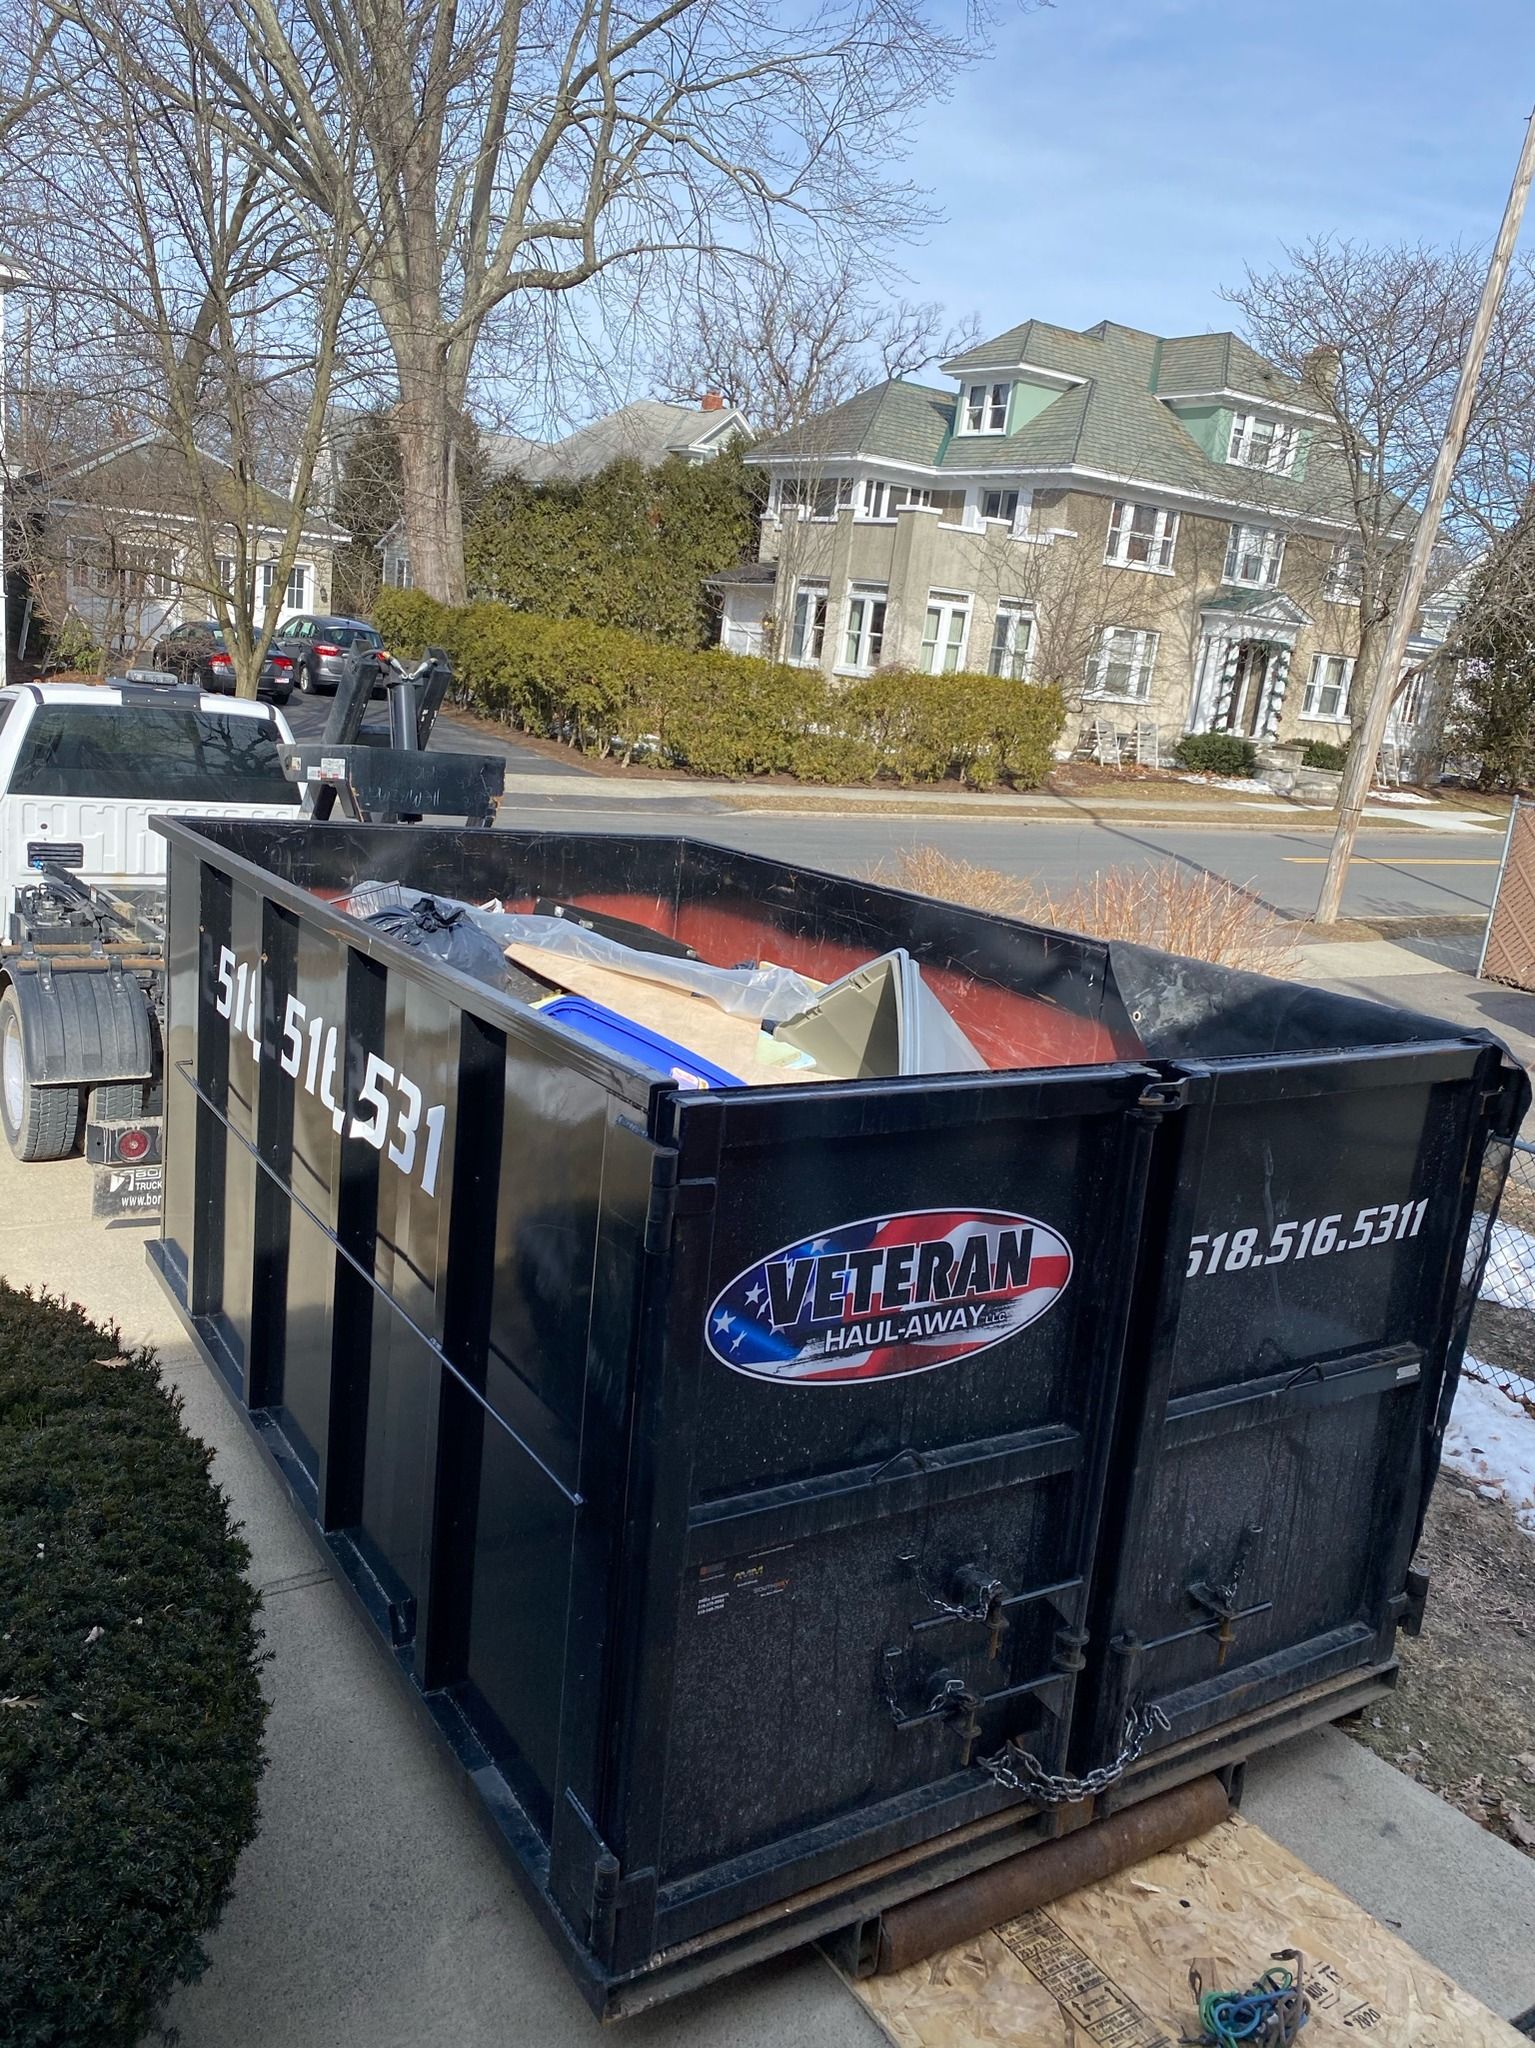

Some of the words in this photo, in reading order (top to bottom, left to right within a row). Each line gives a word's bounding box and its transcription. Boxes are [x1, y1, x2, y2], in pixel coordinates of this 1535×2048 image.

[1186, 1197, 1430, 1279] 518.516.5311
[764, 1227, 1034, 1329] VETERAN
[824, 1303, 986, 1352] HAUL-AWAY
[985, 1312, 1007, 1324] LLC
[1305, 1981, 1329, 2001] AUG
[1352, 2007, 1382, 2030] 2020
